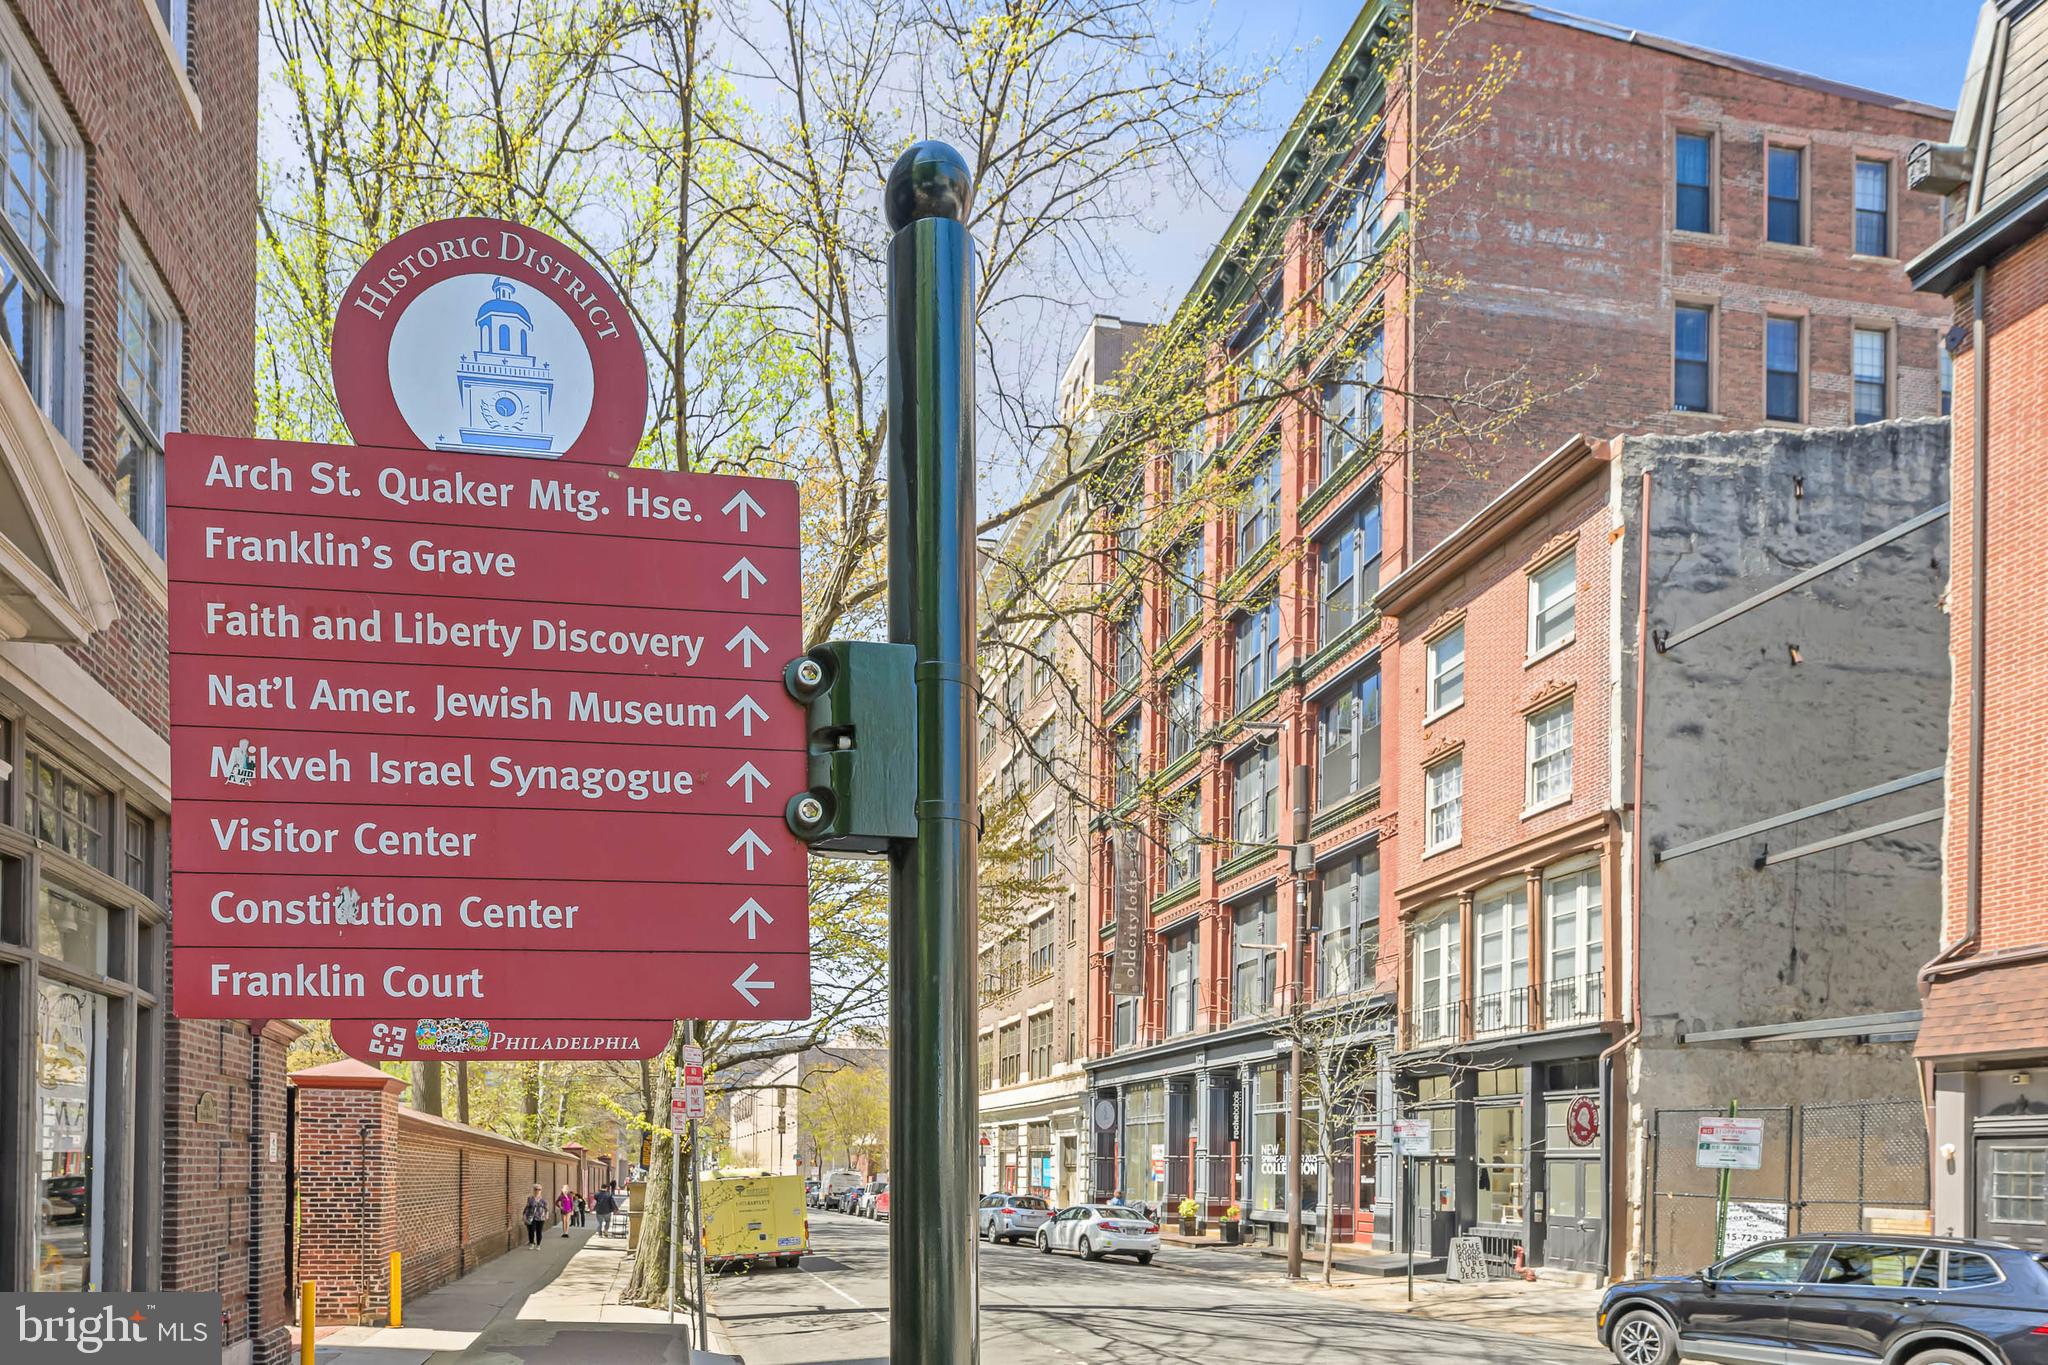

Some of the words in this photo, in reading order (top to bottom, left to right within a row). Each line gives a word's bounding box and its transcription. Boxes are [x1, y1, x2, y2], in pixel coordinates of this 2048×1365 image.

[354, 236, 490, 320] HISTORIC
[497, 232, 620, 340] DISTRICT
[205, 456, 292, 491] Arch
[311, 462, 360, 496] St.
[379, 468, 514, 507] Quaker
[530, 479, 609, 521] Mtg.
[628, 487, 702, 522] Hse.
[410, 540, 515, 576] Grave
[207, 603, 299, 637] Faith
[313, 610, 381, 642] and
[395, 612, 521, 657] Liberty
[533, 620, 704, 666] Discovery
[310, 679, 415, 713] Amer.
[434, 685, 551, 721] Jewish
[569, 692, 716, 727] Museum
[210, 745, 350, 782] Mikveh
[371, 752, 474, 786] Israel
[490, 757, 692, 800] Synagogue
[211, 818, 339, 852] Visitor
[355, 823, 476, 856] Center
[460, 896, 579, 928] Center
[212, 964, 364, 996] Franklin
[383, 966, 484, 998] Court
[488, 1032, 640, 1049] PHILADELPHIA
[1261, 1144, 1280, 1155] NEW
